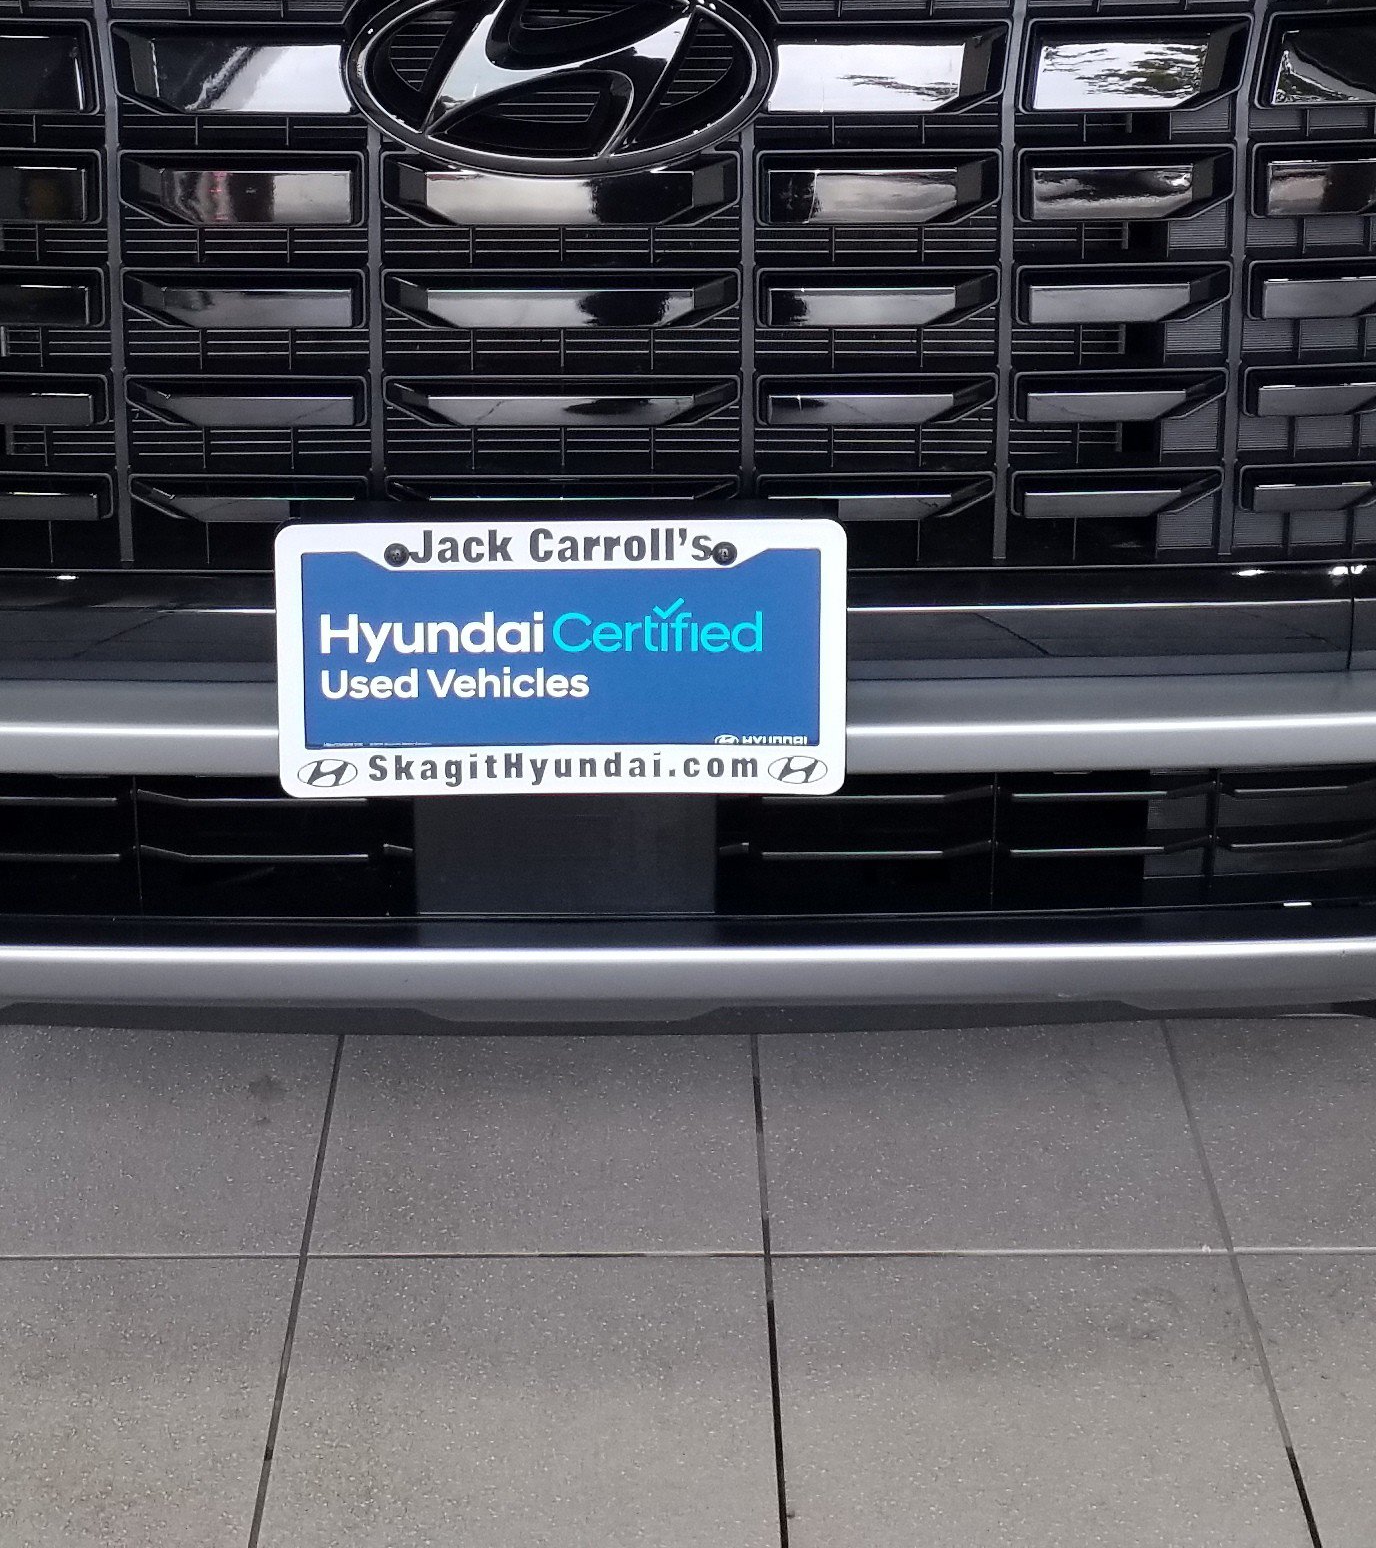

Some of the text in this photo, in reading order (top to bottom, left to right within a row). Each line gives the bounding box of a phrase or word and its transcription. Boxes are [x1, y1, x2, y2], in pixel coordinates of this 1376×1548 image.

[409, 527, 713, 564] Jack Carroll's
[319, 599, 764, 663] Hyundai Certified
[321, 667, 591, 700] Used Vehicles
[368, 752, 759, 788] SkagitHyundai.com
